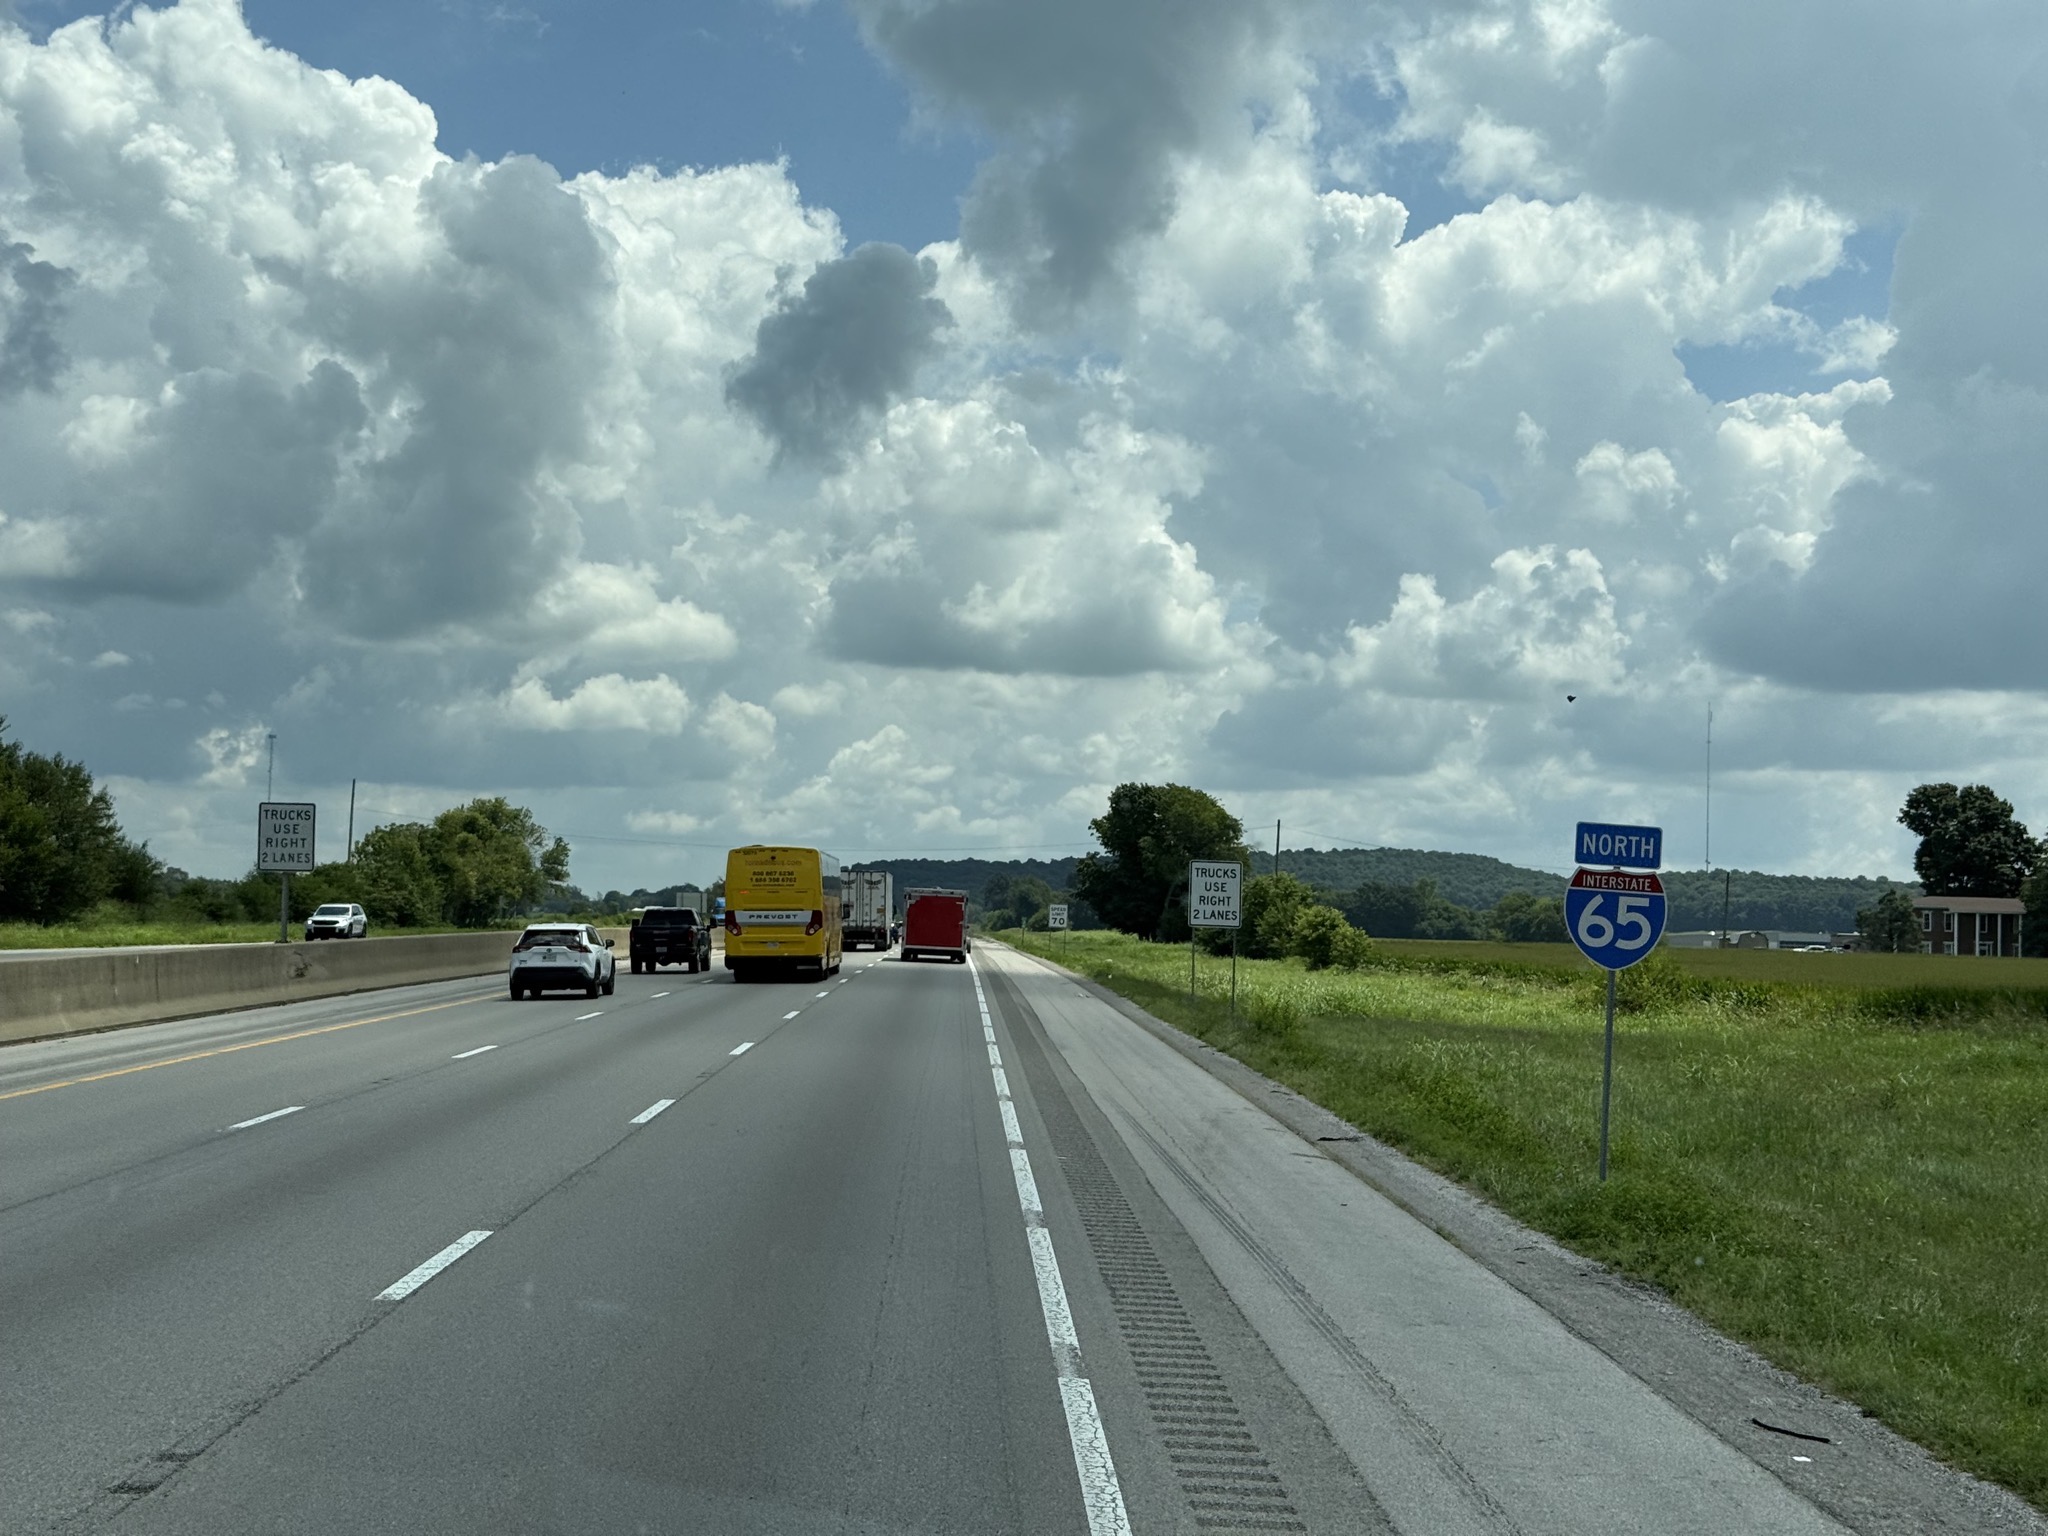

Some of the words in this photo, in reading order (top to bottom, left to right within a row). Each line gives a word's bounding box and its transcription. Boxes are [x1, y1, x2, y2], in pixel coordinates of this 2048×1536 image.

[263, 809, 311, 820] TRUCKS
[273, 823, 300, 834] USE
[265, 837, 307, 848] RIGHT
[1583, 832, 1654, 859] NORTH
[262, 852, 268, 863] 2
[273, 852, 311, 864] LANES
[1195, 867, 1237, 879] TRUCKS
[1204, 881, 1227, 892] USE
[1582, 874, 1652, 891] INTERSTATE
[1199, 895, 1232, 906] RIGHT
[1193, 909, 1200, 920] 2
[1203, 909, 1238, 921] LANES
[1051, 917, 1065, 926] 70
[1578, 894, 1651, 950] 65
